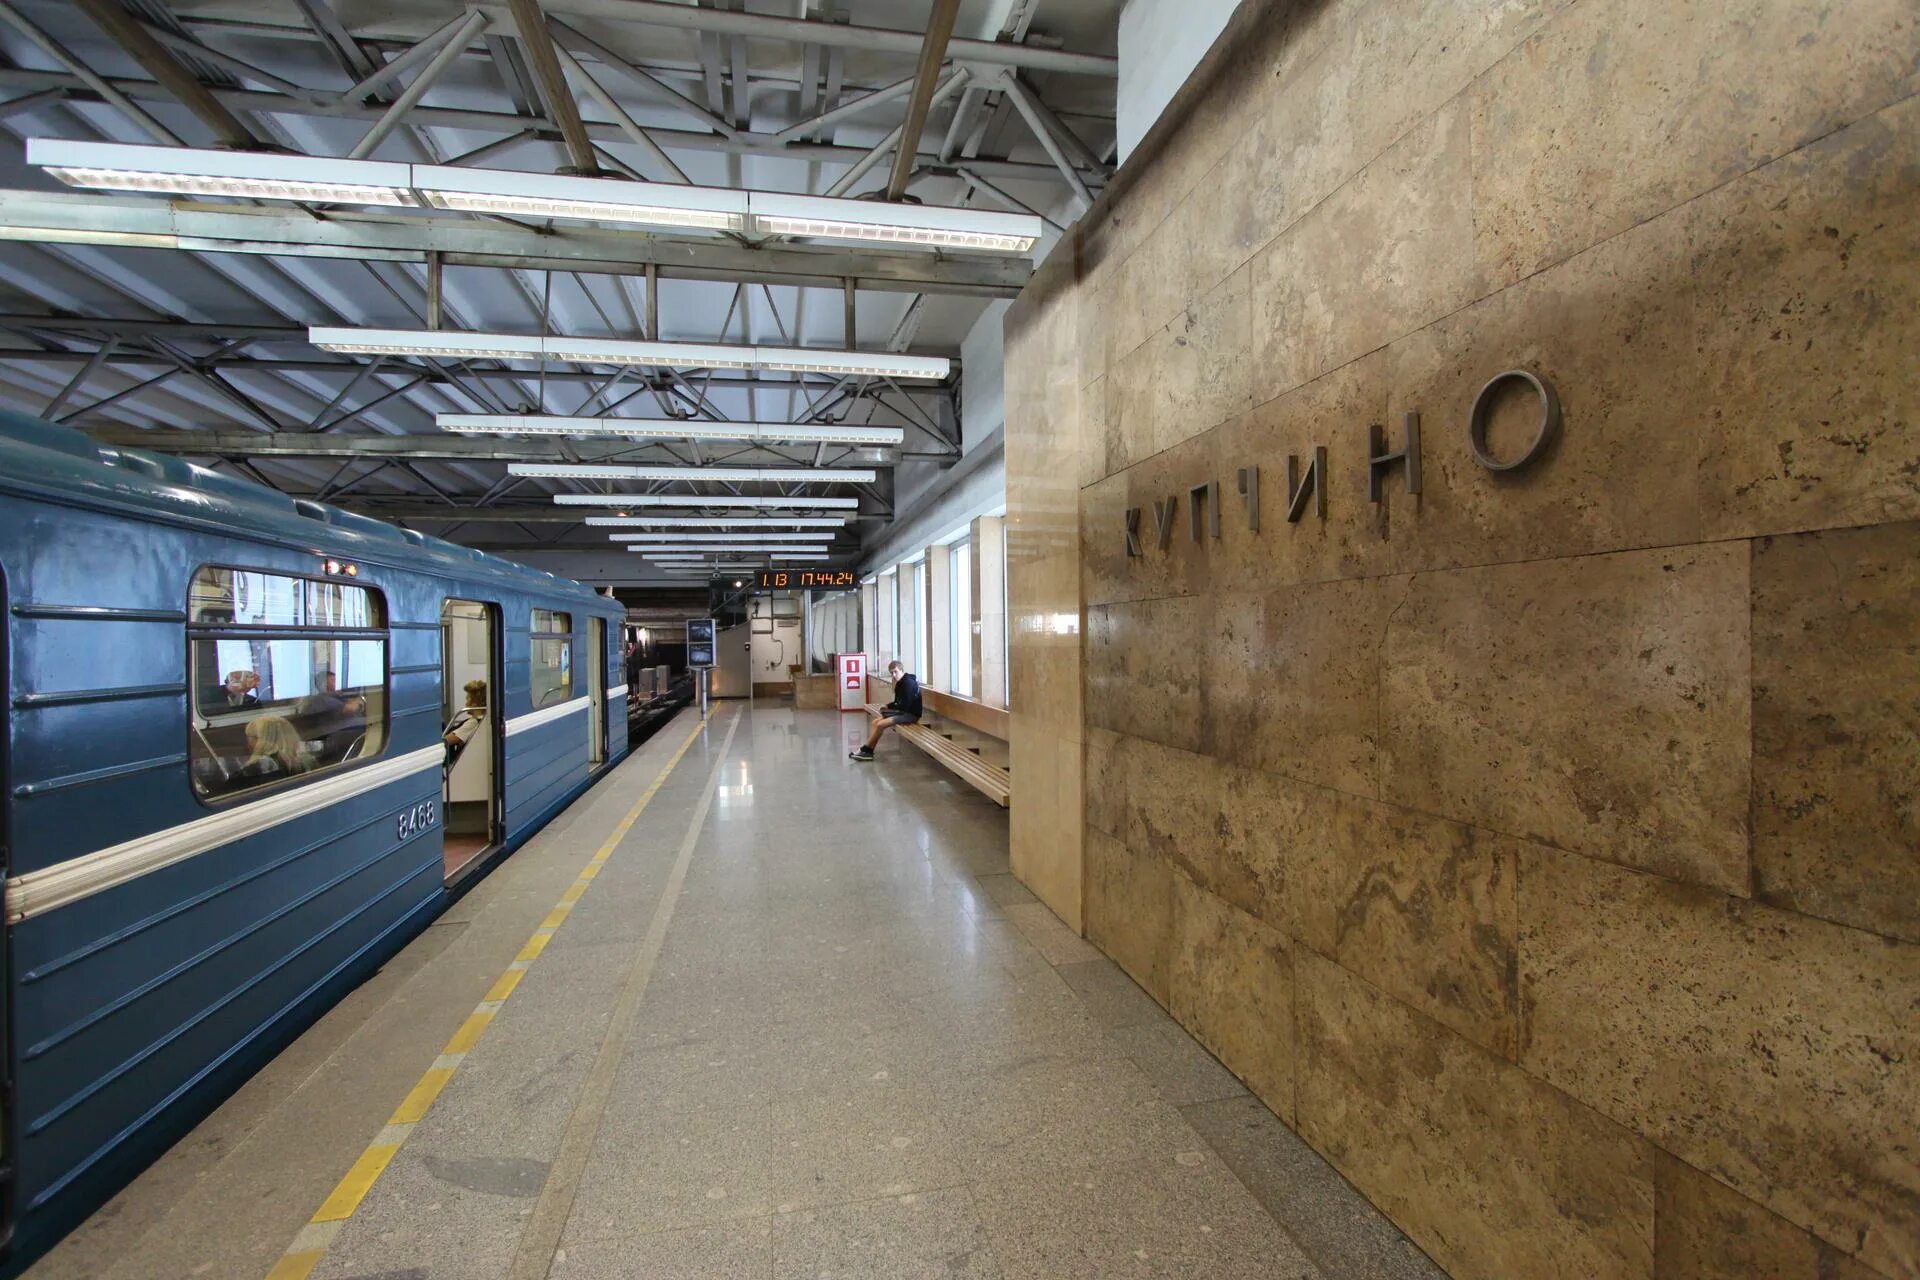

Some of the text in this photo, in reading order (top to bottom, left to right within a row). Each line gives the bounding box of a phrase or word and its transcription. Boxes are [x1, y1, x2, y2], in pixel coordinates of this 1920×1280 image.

[1126, 370, 1562, 557] КУПЧИНО
[801, 572, 853, 586] 17.44.24
[399, 800, 435, 840] 8468
